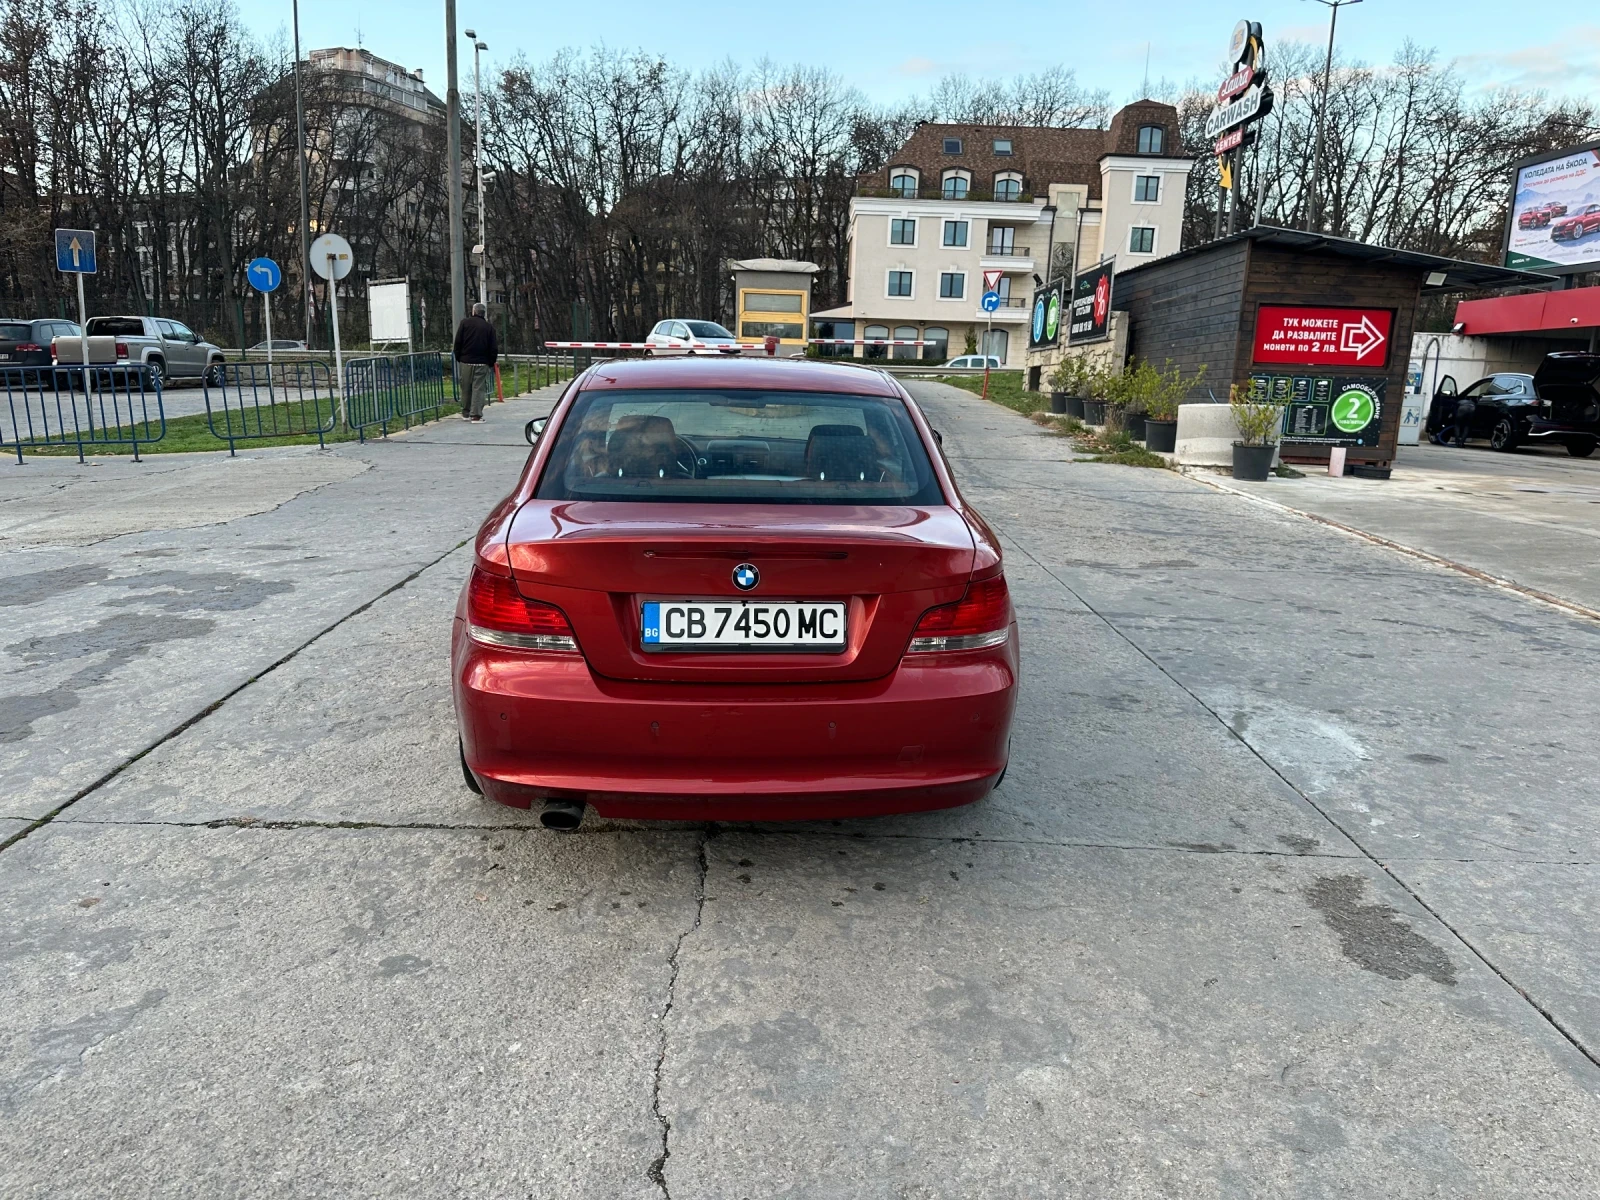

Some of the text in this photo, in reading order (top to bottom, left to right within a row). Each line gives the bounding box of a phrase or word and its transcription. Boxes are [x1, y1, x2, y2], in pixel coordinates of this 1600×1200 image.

[1207, 92, 1259, 134] CARWASH
[1215, 132, 1242, 153] CENTER
[1524, 158, 1587, 179] КОЛЕДАТА НА ŠKODA
[1575, 168, 1587, 178] ДДС
[1283, 318, 1339, 328] ТУК МОЖЕТЕ
[1272, 330, 1337, 341] ДА РАЗВАЛИТЕ
[1263, 342, 1338, 353] монети по 2 лв.
[1342, 383, 1381, 419] САМООБСЛУЖВАНЕ
[1346, 398, 1361, 419] 2
[644, 628, 659, 638] BG
[665, 607, 839, 639] CB 7450 MC
